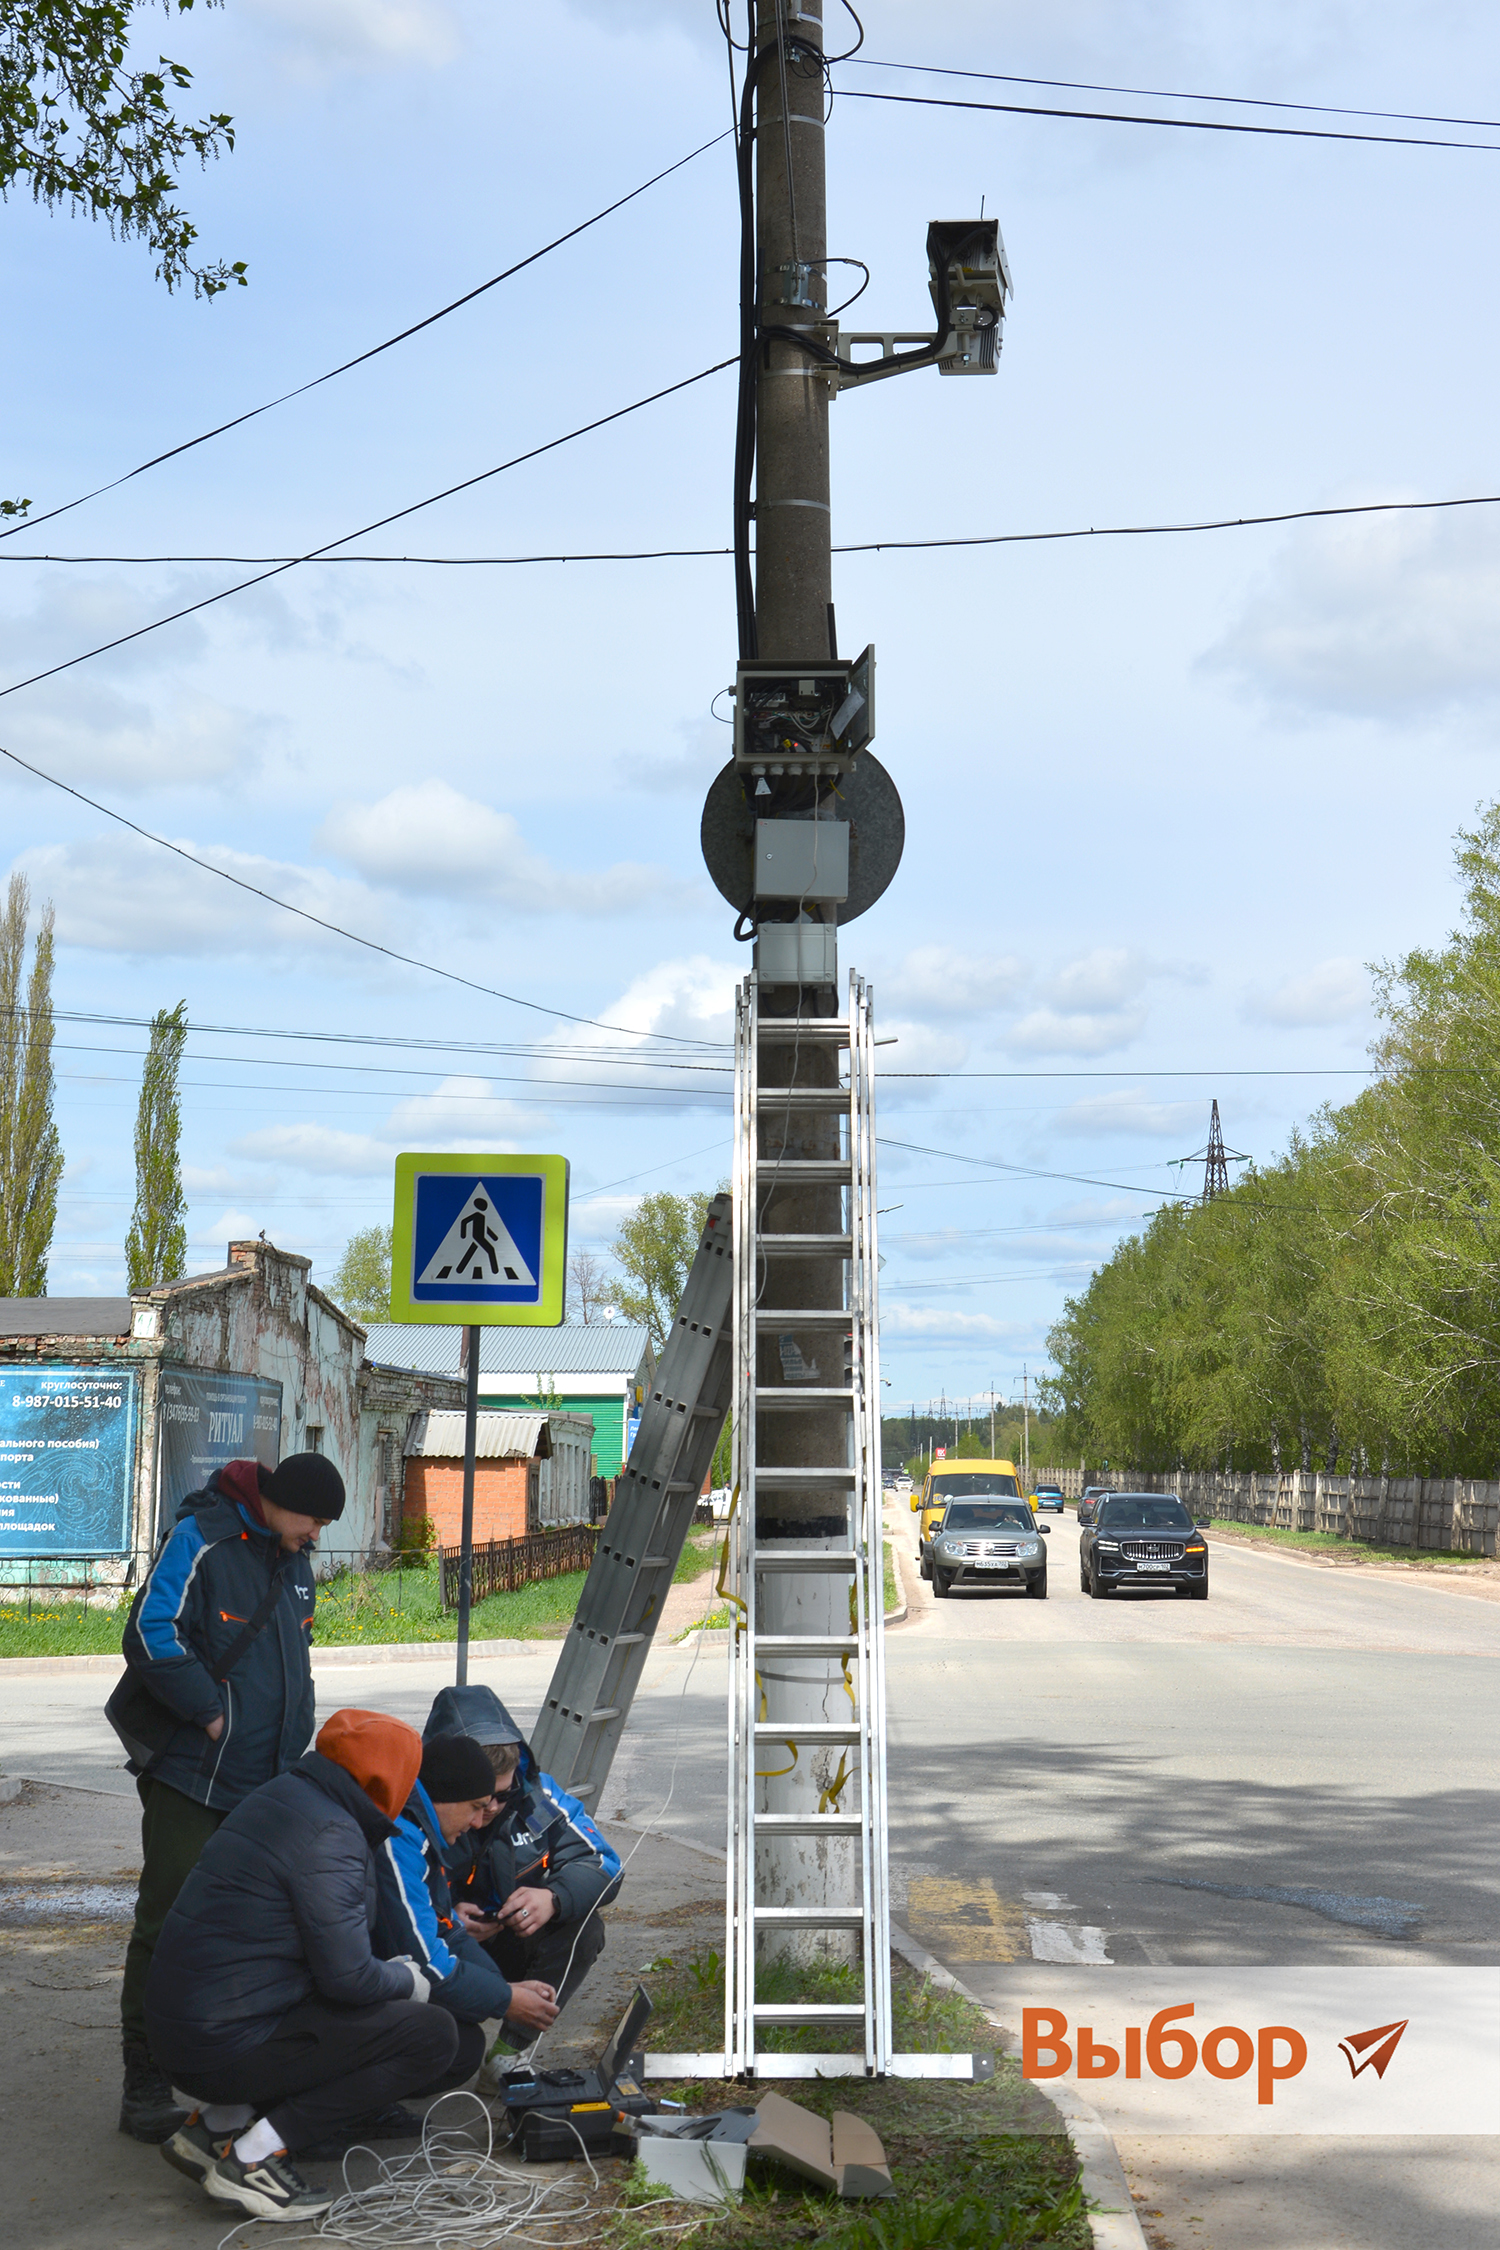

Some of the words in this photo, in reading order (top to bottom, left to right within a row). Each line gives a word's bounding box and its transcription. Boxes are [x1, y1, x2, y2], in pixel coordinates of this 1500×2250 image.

[41, 1381, 123, 1392] круглосуточно:
[12, 1395, 122, 1408] 8-987-015-51-40
[207, 1411, 244, 1446] РИТУАЛ
[47, 1438, 100, 1450] пособия)
[0, 1454, 34, 1464] порта
